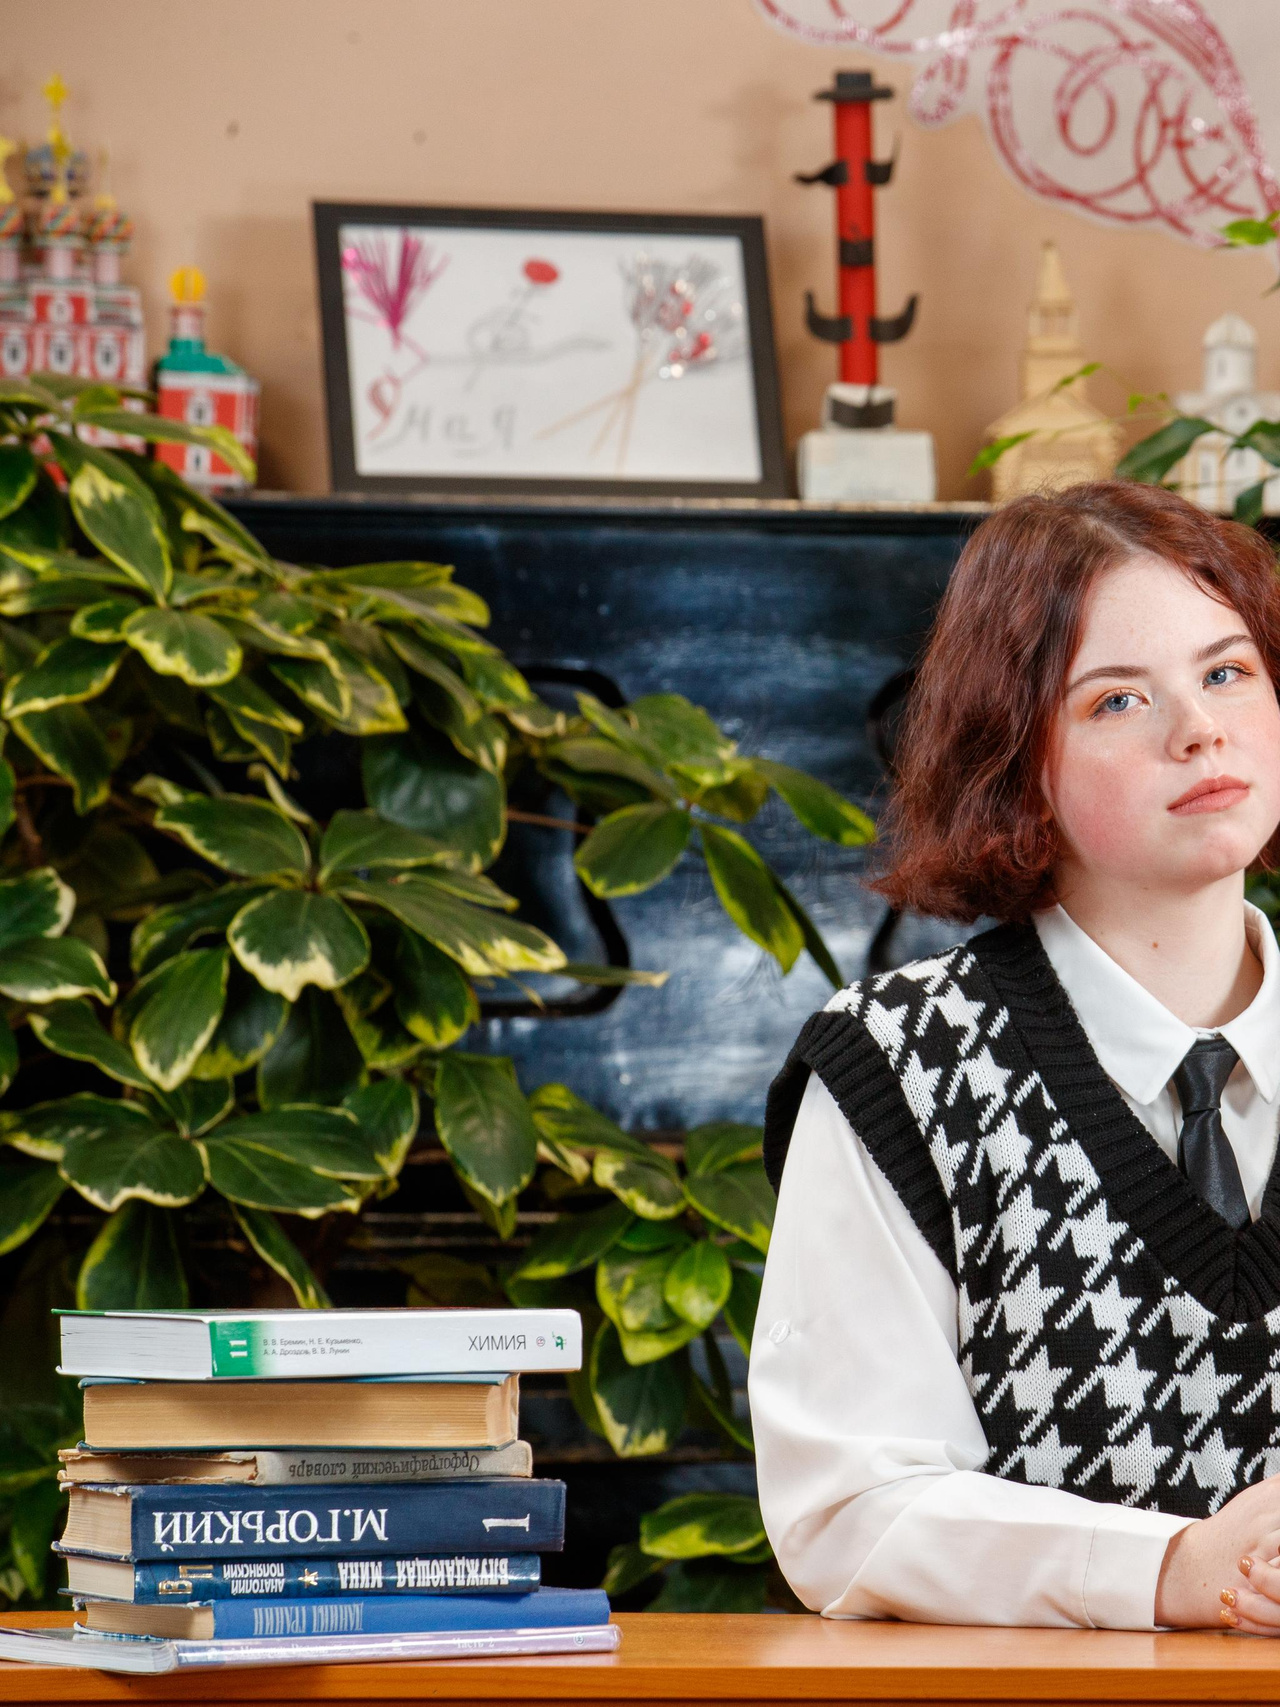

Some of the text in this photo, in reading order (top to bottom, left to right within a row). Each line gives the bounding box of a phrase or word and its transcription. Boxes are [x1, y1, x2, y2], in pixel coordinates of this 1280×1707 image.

[229, 1340, 248, 1358] 11
[468, 1334, 527, 1351] ХИМИЯ
[288, 1452, 480, 1480] Орфографический словарь
[481, 1513, 531, 1533] 1
[222, 1562, 285, 1581] ПОЛЯНСКИЙ
[337, 1557, 509, 1590] БЛУЖДАЮЩАЯ МИНА
[231, 1577, 286, 1596] АНАТОЛИЙ
[252, 1602, 365, 1635] ДАНИИЛ ГРАНИН
